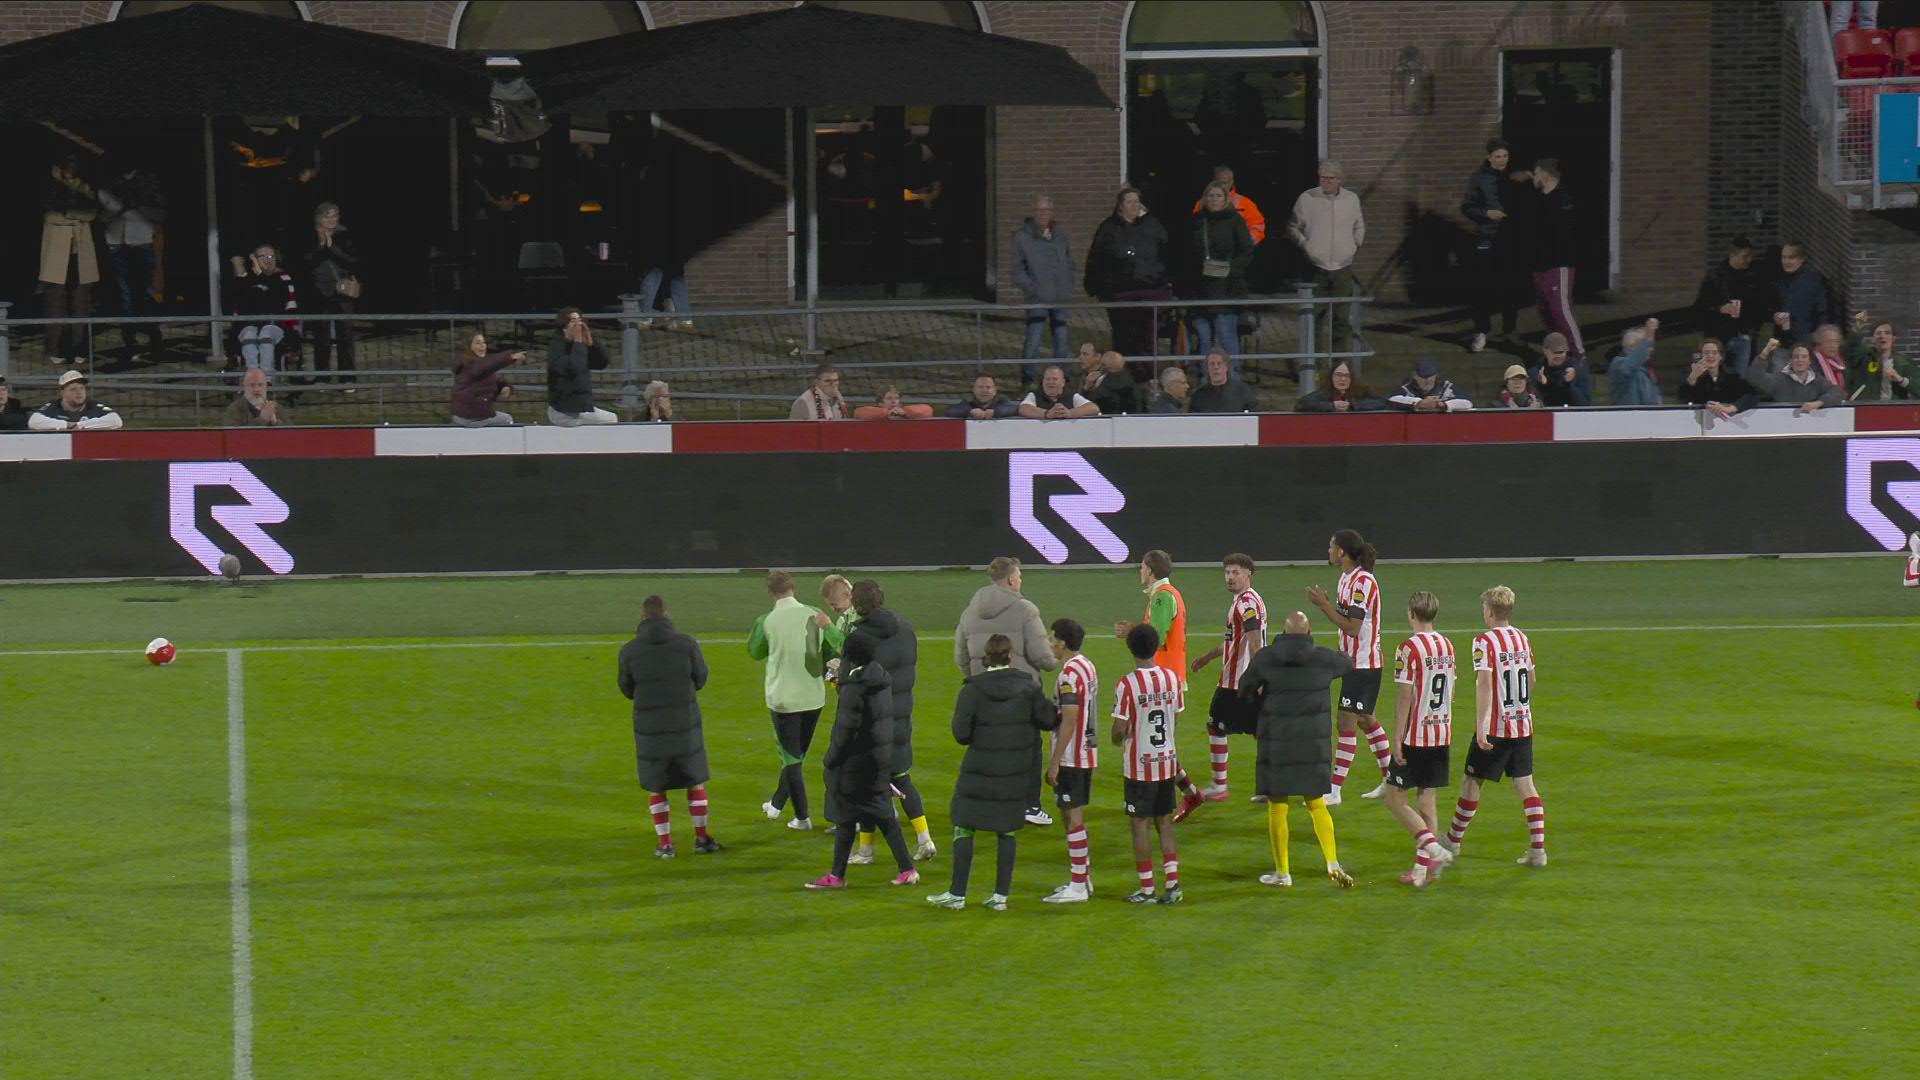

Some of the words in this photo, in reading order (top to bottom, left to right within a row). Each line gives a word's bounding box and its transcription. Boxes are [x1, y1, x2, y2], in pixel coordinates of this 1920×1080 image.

[169, 461, 295, 575] R
[1009, 451, 1130, 564] R
[1429, 673, 1447, 711] 9
[1503, 668, 1529, 708] 10
[1148, 709, 1167, 748] 3
